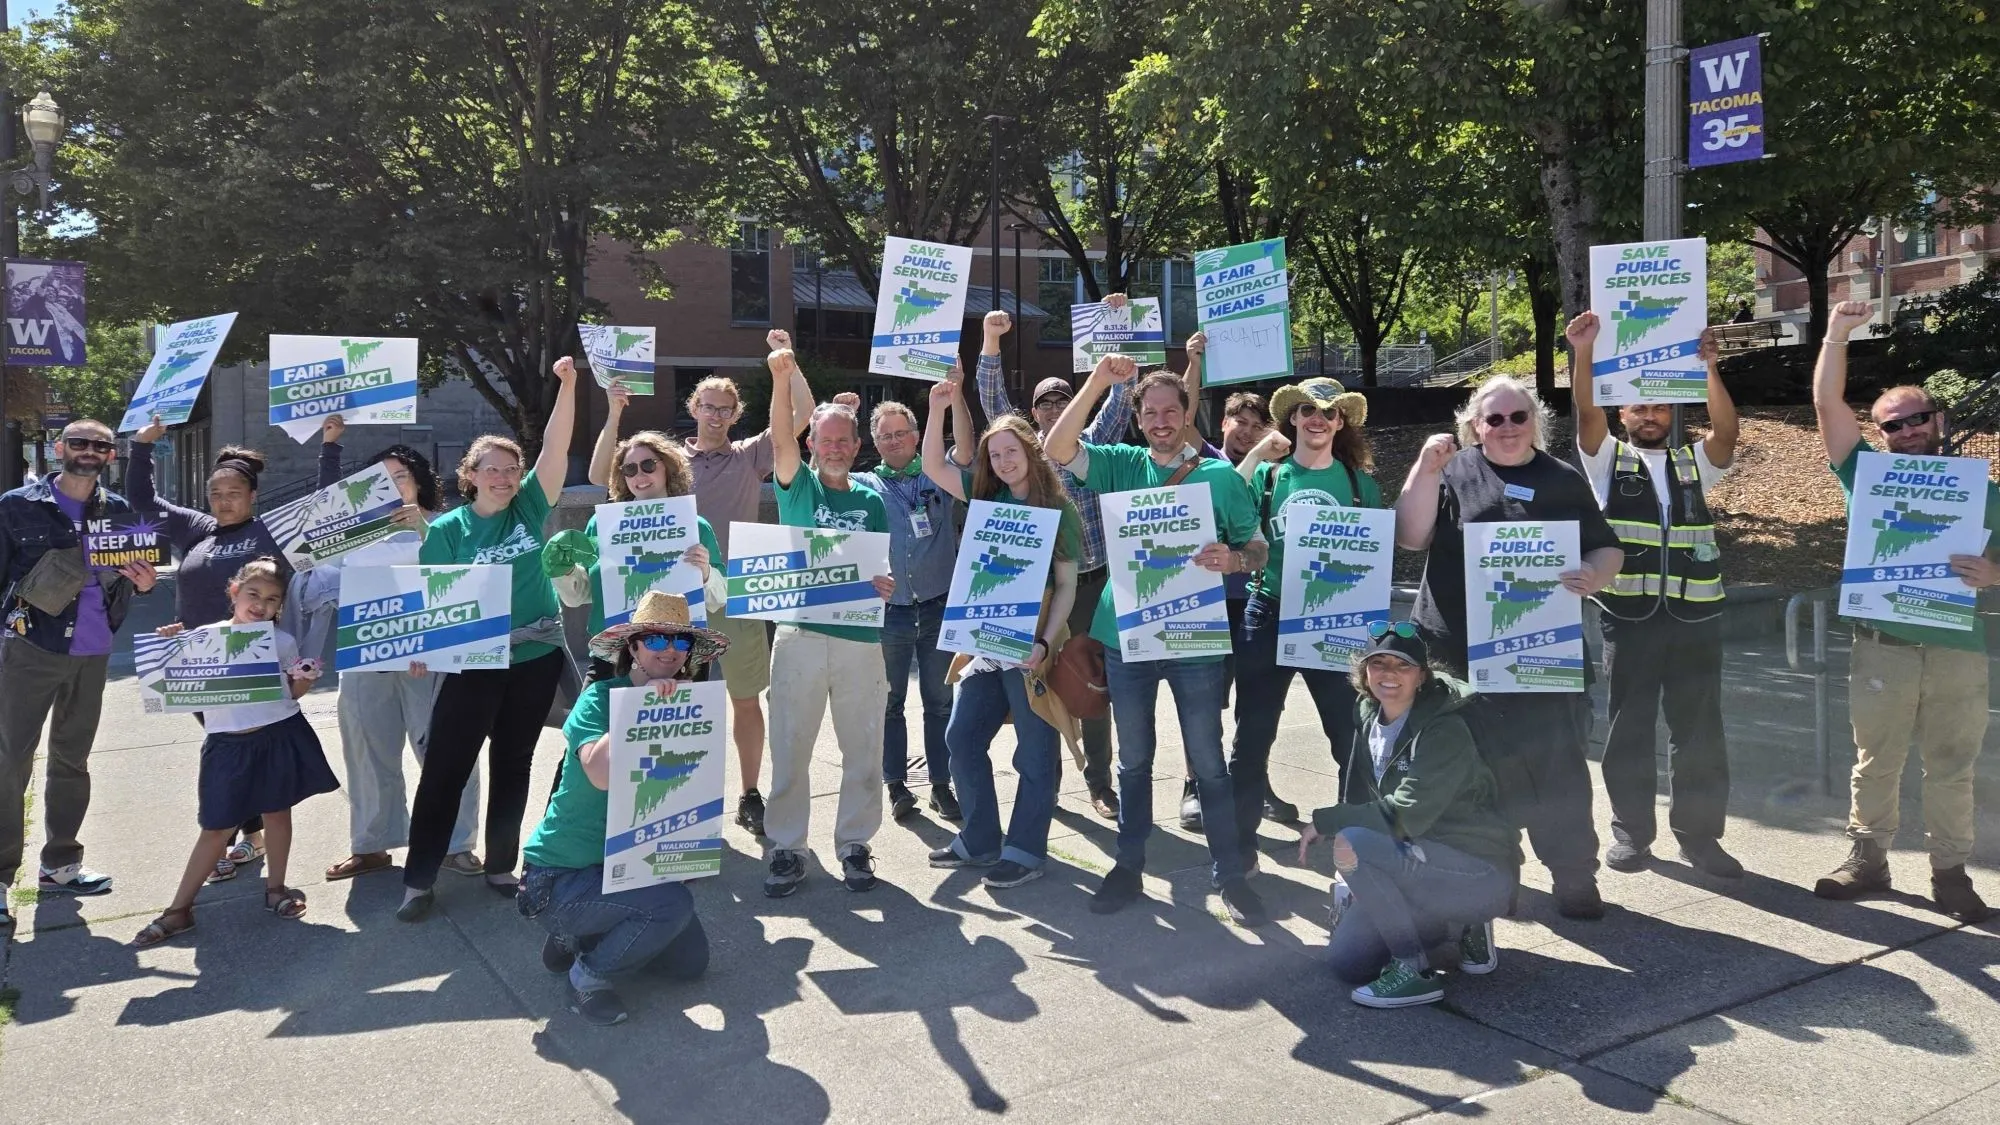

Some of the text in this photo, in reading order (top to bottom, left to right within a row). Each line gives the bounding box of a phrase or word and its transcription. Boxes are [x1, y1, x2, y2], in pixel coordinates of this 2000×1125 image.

[1700, 51, 1750, 93] W
[1690, 91, 1763, 115] TACOMA
[1702, 114, 1749, 151] 35
[909, 244, 946, 258] SAVE
[1622, 246, 1670, 260] SAVE
[902, 255, 953, 271] PUBLIC
[1615, 259, 1681, 274] PUBLIC
[893, 266, 958, 284] SERVICES
[1203, 264, 1255, 287] A FAIR
[1605, 272, 1692, 288] SERVICES
[1206, 274, 1281, 302] CONTRACT
[1208, 294, 1265, 318] MEANS
[7, 318, 53, 345] W
[185, 319, 216, 330] SAVE
[176, 327, 217, 340] PUBLIC
[892, 333, 941, 345] 8.31.26
[166, 334, 218, 350] SERVICES
[1092, 344, 1120, 352] WITH
[9, 347, 52, 355] TACOMA
[911, 350, 941, 361] WALKOUT
[1618, 345, 1681, 369] 8.31.26
[907, 356, 928, 366] WITH
[283, 364, 328, 383] FAIR
[287, 370, 389, 400] CONTRACT
[290, 396, 346, 418] NOW!
[1892, 458, 1949, 473] SAVE
[1883, 471, 1961, 488] PUBLIC
[1131, 491, 1176, 508] SAVE
[1869, 484, 1970, 503] SERVICES
[315, 510, 349, 526] 8.31.26
[624, 503, 664, 517] SAVE
[992, 507, 1032, 521] SAVE
[1126, 505, 1189, 523] PUBLIC
[1315, 510, 1361, 524] SAVE
[87, 519, 112, 533] WE
[308, 516, 360, 538] WALKOUT
[619, 515, 676, 531] PUBLIC
[984, 519, 1038, 535] PUBLIC
[1118, 518, 1201, 538] SERVICES
[1309, 523, 1371, 538] PUBLIC
[611, 527, 686, 545] SERVICES
[974, 530, 1043, 549] SERVICES
[1495, 526, 1544, 539] SAVE
[88, 532, 157, 550] KEEP UW
[309, 532, 345, 550] WITH
[318, 529, 388, 557] WASHINGTON
[1298, 536, 1380, 553] SERVICES
[1489, 540, 1556, 554] PUBLIC
[89, 549, 160, 567] RUNNING!
[473, 536, 540, 564] AFSCME
[741, 555, 789, 574] FAIR
[1479, 555, 1566, 568] SERVICES
[744, 566, 856, 593] CONTRACT
[1873, 565, 1947, 581] 8.31.26
[748, 591, 806, 612] NOW!
[1896, 595, 1929, 607] WITH
[1902, 587, 1950, 600] WALKOUT
[353, 597, 404, 621] FAIR
[965, 605, 1018, 618] 8.31.26
[1141, 595, 1200, 622] 8.31.26
[356, 603, 477, 642] CONTRACT
[984, 624, 1016, 637] WALKOUT
[1304, 614, 1364, 631] 8.31.26
[978, 632, 1001, 643] WITH
[1165, 632, 1193, 640] WITH
[1328, 636, 1366, 647] WALKOUT
[1494, 631, 1556, 654] 8.31.26
[359, 635, 424, 663] NOW!
[1323, 644, 1350, 654] WITH
[181, 657, 219, 666] 8.31.26
[465, 655, 504, 663] AFSCME
[1520, 656, 1561, 665] WALKOUT
[170, 667, 230, 677] WALKOUT
[1517, 666, 1545, 675] WITH
[166, 681, 207, 692] WITH
[171, 693, 250, 704] WASHINGTON
[643, 688, 692, 706] SAVE
[636, 704, 703, 725] PUBLIC
[625, 720, 713, 743] SERVICES
[634, 809, 698, 844] 8.31.26
[660, 842, 700, 851] WALKOUT
[655, 852, 683, 863] WITH
